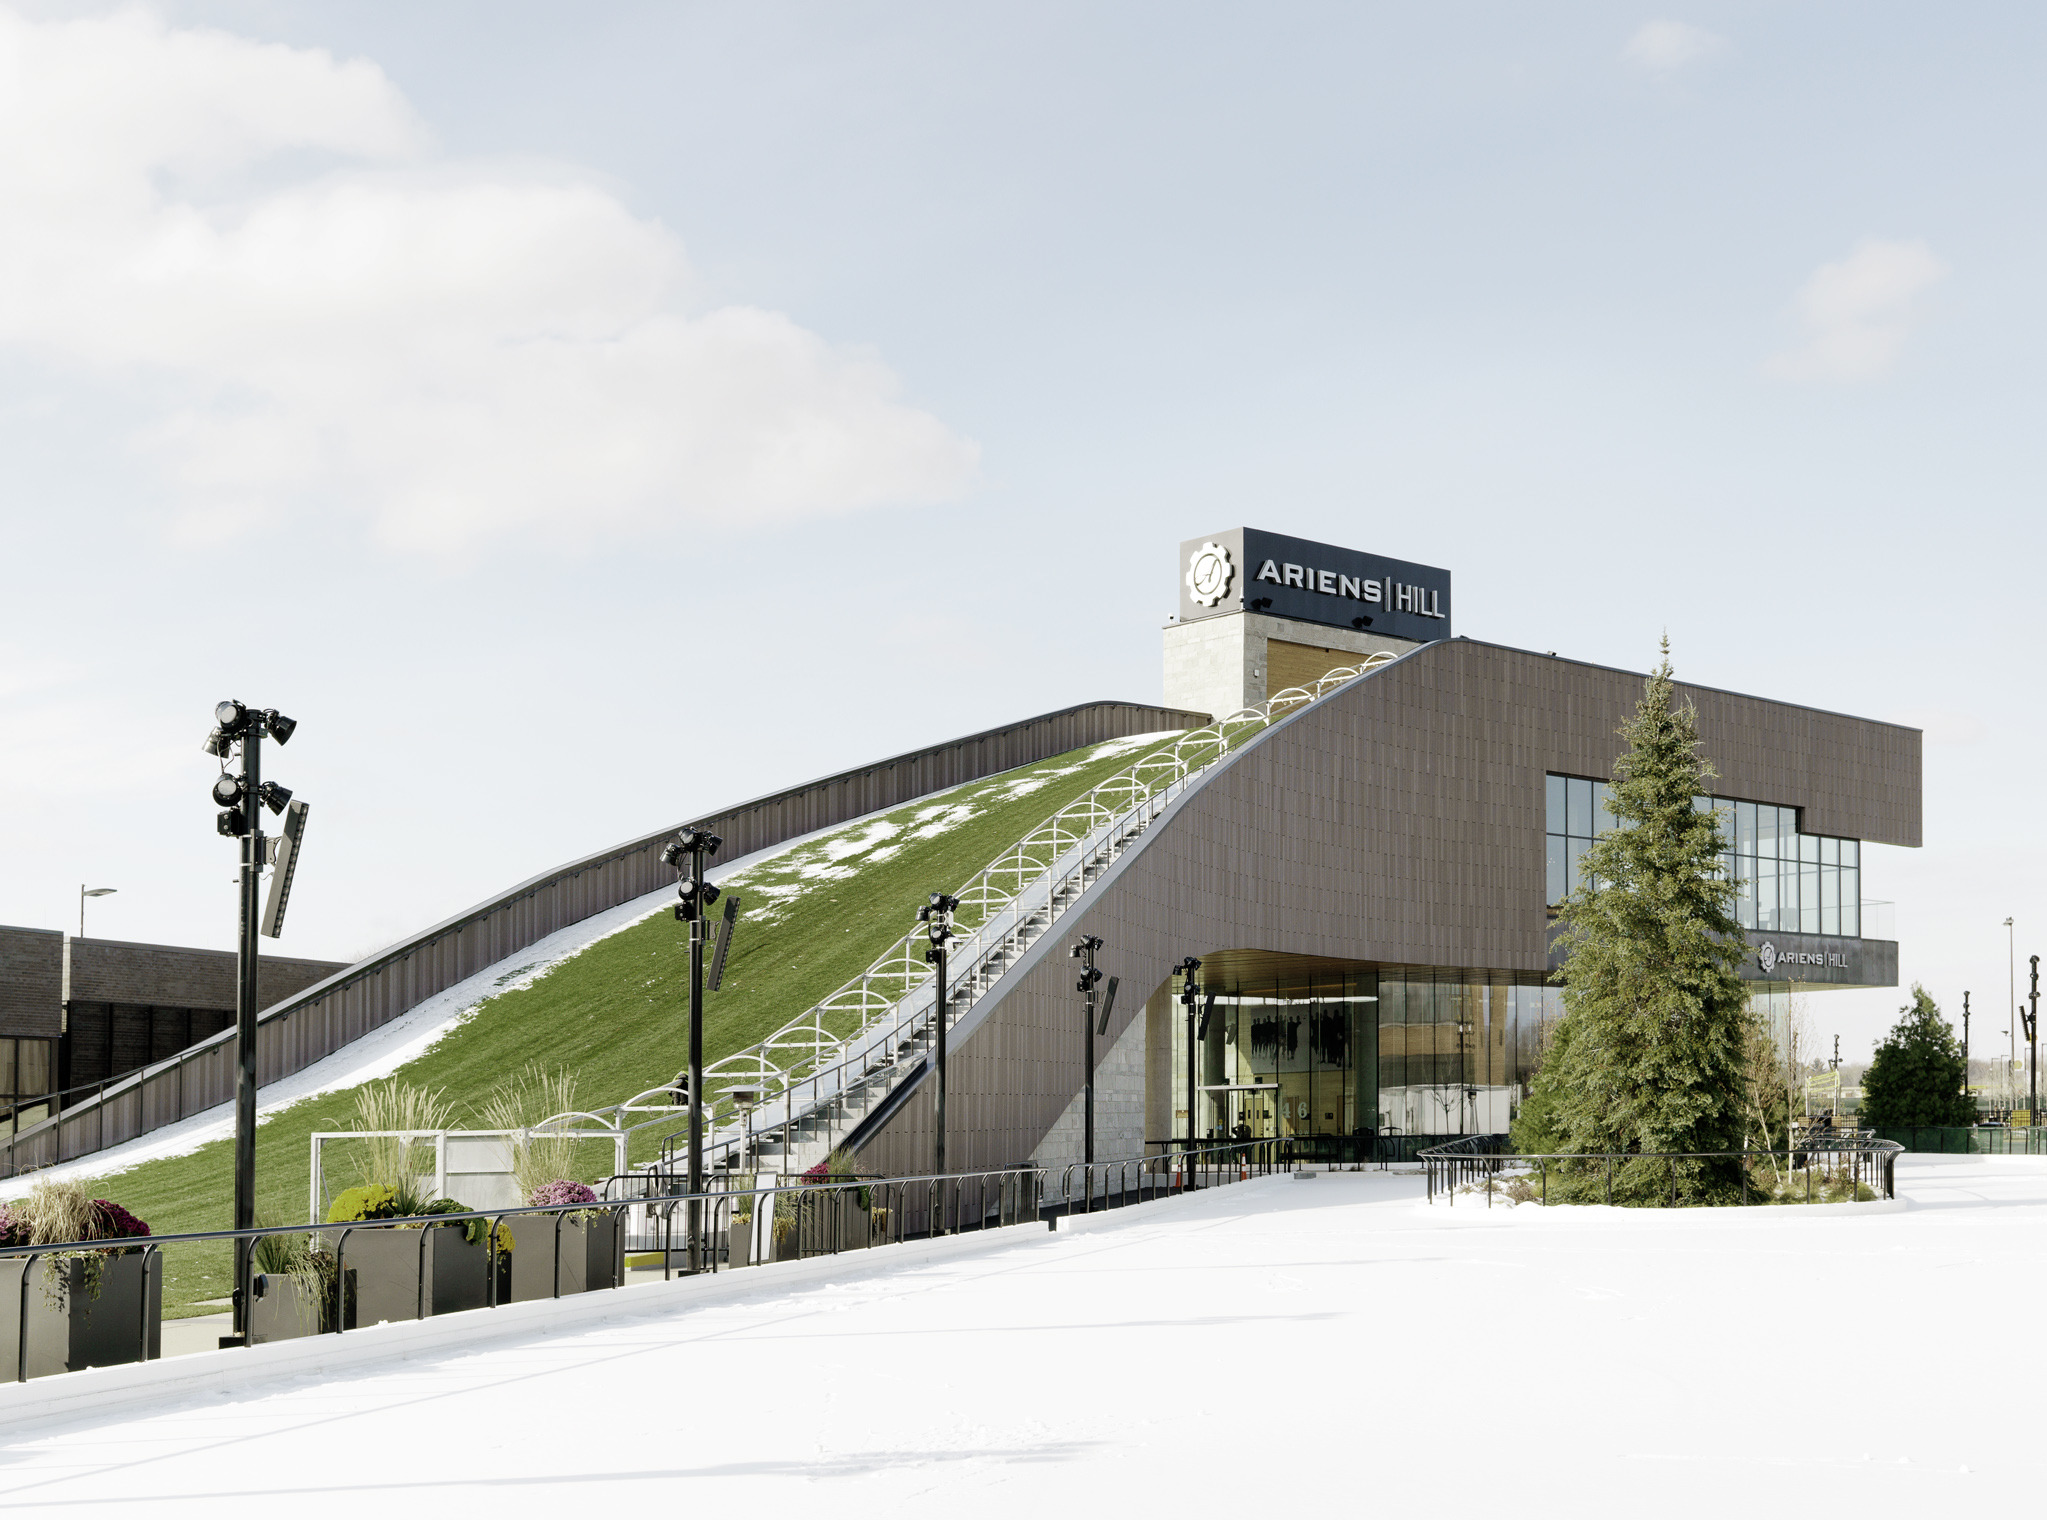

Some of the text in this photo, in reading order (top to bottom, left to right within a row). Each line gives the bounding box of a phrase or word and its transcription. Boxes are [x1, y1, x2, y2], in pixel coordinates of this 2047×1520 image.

[1256, 559, 1446, 619] ARIENS HILL
[1777, 951, 1848, 968] ARIENS HILL
